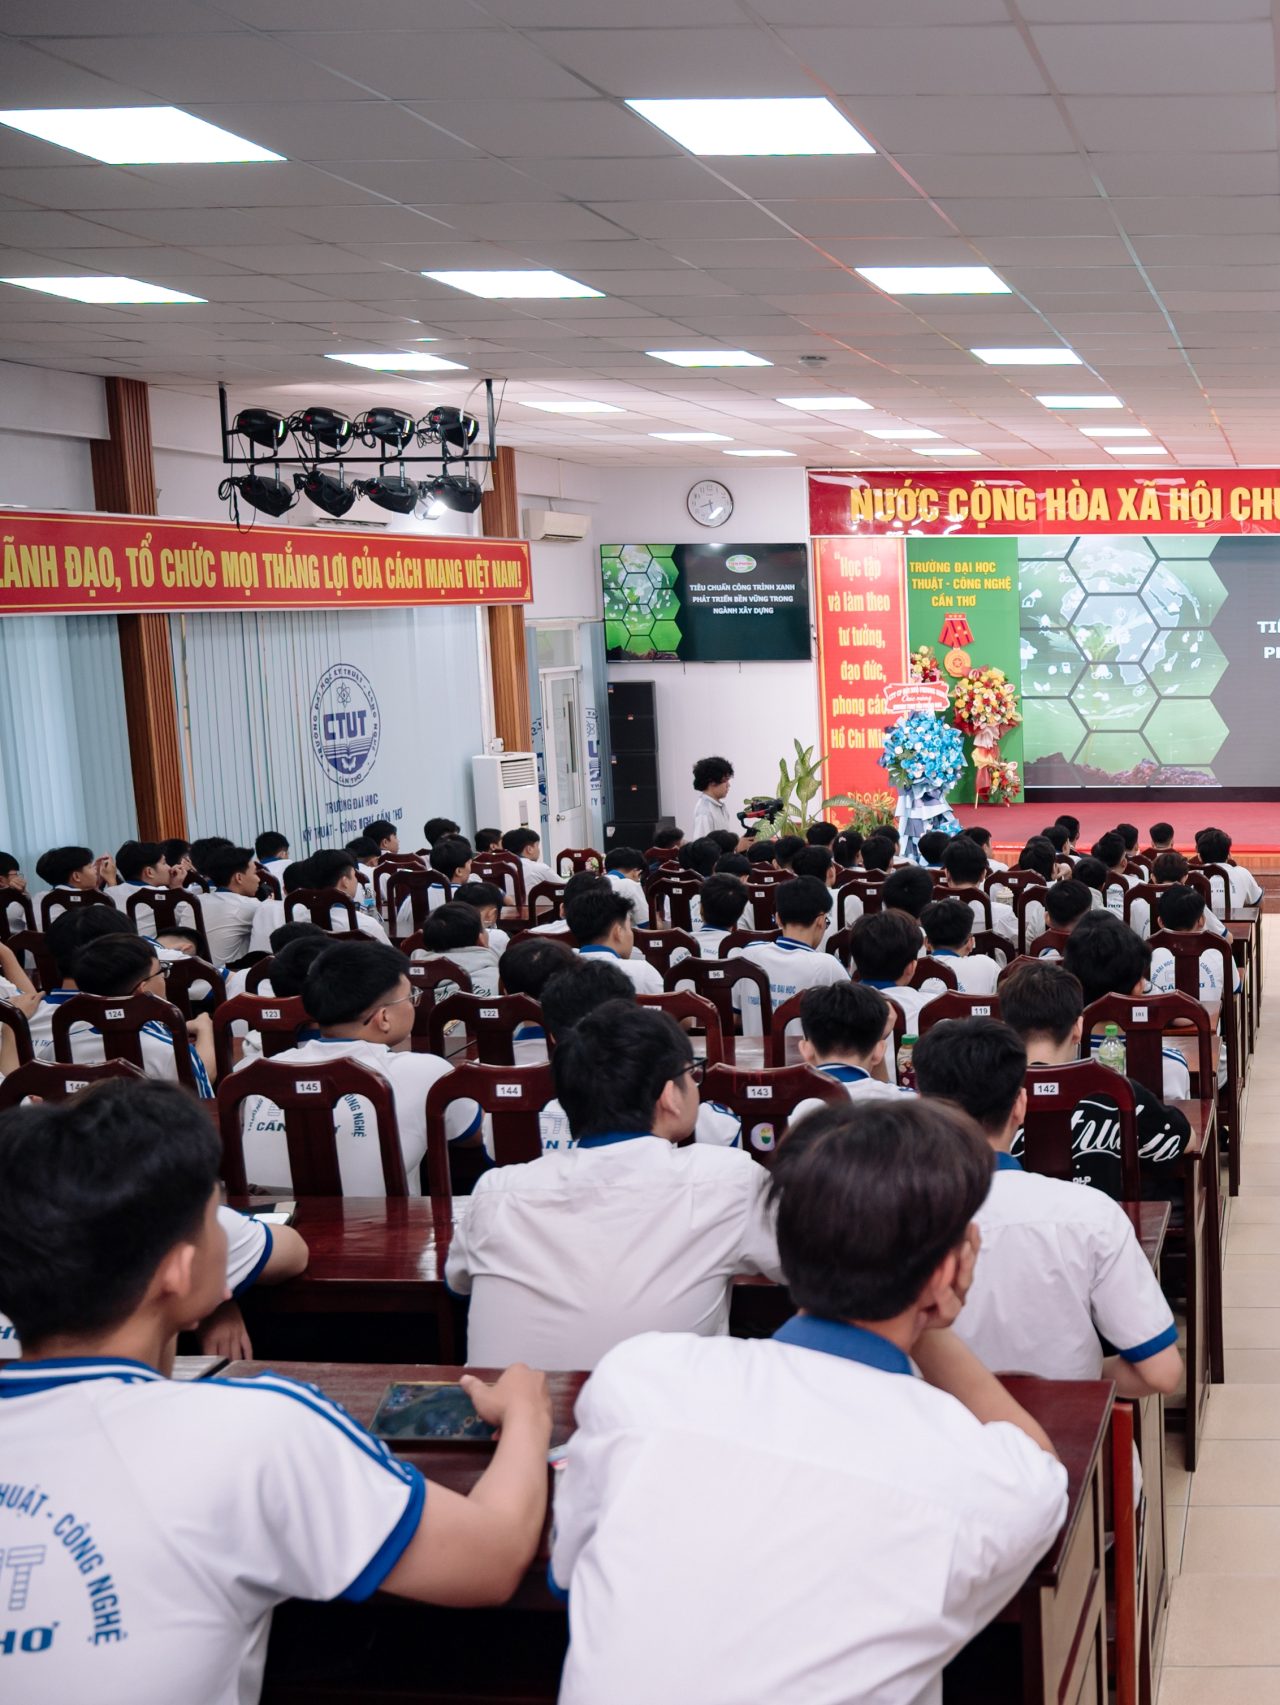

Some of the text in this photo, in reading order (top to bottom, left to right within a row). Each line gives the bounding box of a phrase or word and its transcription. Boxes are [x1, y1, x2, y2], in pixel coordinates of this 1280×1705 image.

[851, 479, 939, 521] NƯỚC
[948, 480, 1037, 528] CỘNG
[1046, 479, 1110, 521] HÒA
[1117, 480, 1161, 521] XÃ
[1170, 480, 1222, 528] HỘI
[0, 532, 522, 597] ÃNH ĐẠO, TỔ CHỨC MỌI THẮNG LỢI CỦA CÁCH MẠNG VIỆT NAM!
[864, 556, 881, 580] tập
[909, 559, 996, 575] TRƯỜNG ĐẠI HỌC
[912, 576, 1012, 591] THUẬT CÔNG NGHỆ
[828, 591, 890, 612] và làm theo
[957, 594, 977, 607] THƠ
[838, 624, 886, 648] tư tưởng,
[840, 660, 887, 685] đạo đức,
[832, 694, 865, 717] phong
[323, 710, 367, 741] CTUT
[831, 726, 845, 748] Hồ
[847, 727, 865, 748] Chí
[108, 1010, 121, 1018] 124
[974, 1007, 988, 1015] 119
[300, 1083, 318, 1091] 145
[501, 1087, 519, 1095] 144
[752, 1088, 769, 1097] 143
[1038, 1085, 1056, 1093] 142
[53, 1512, 104, 1575] CÔNG
[86, 1574, 129, 1647] NGHỆ
